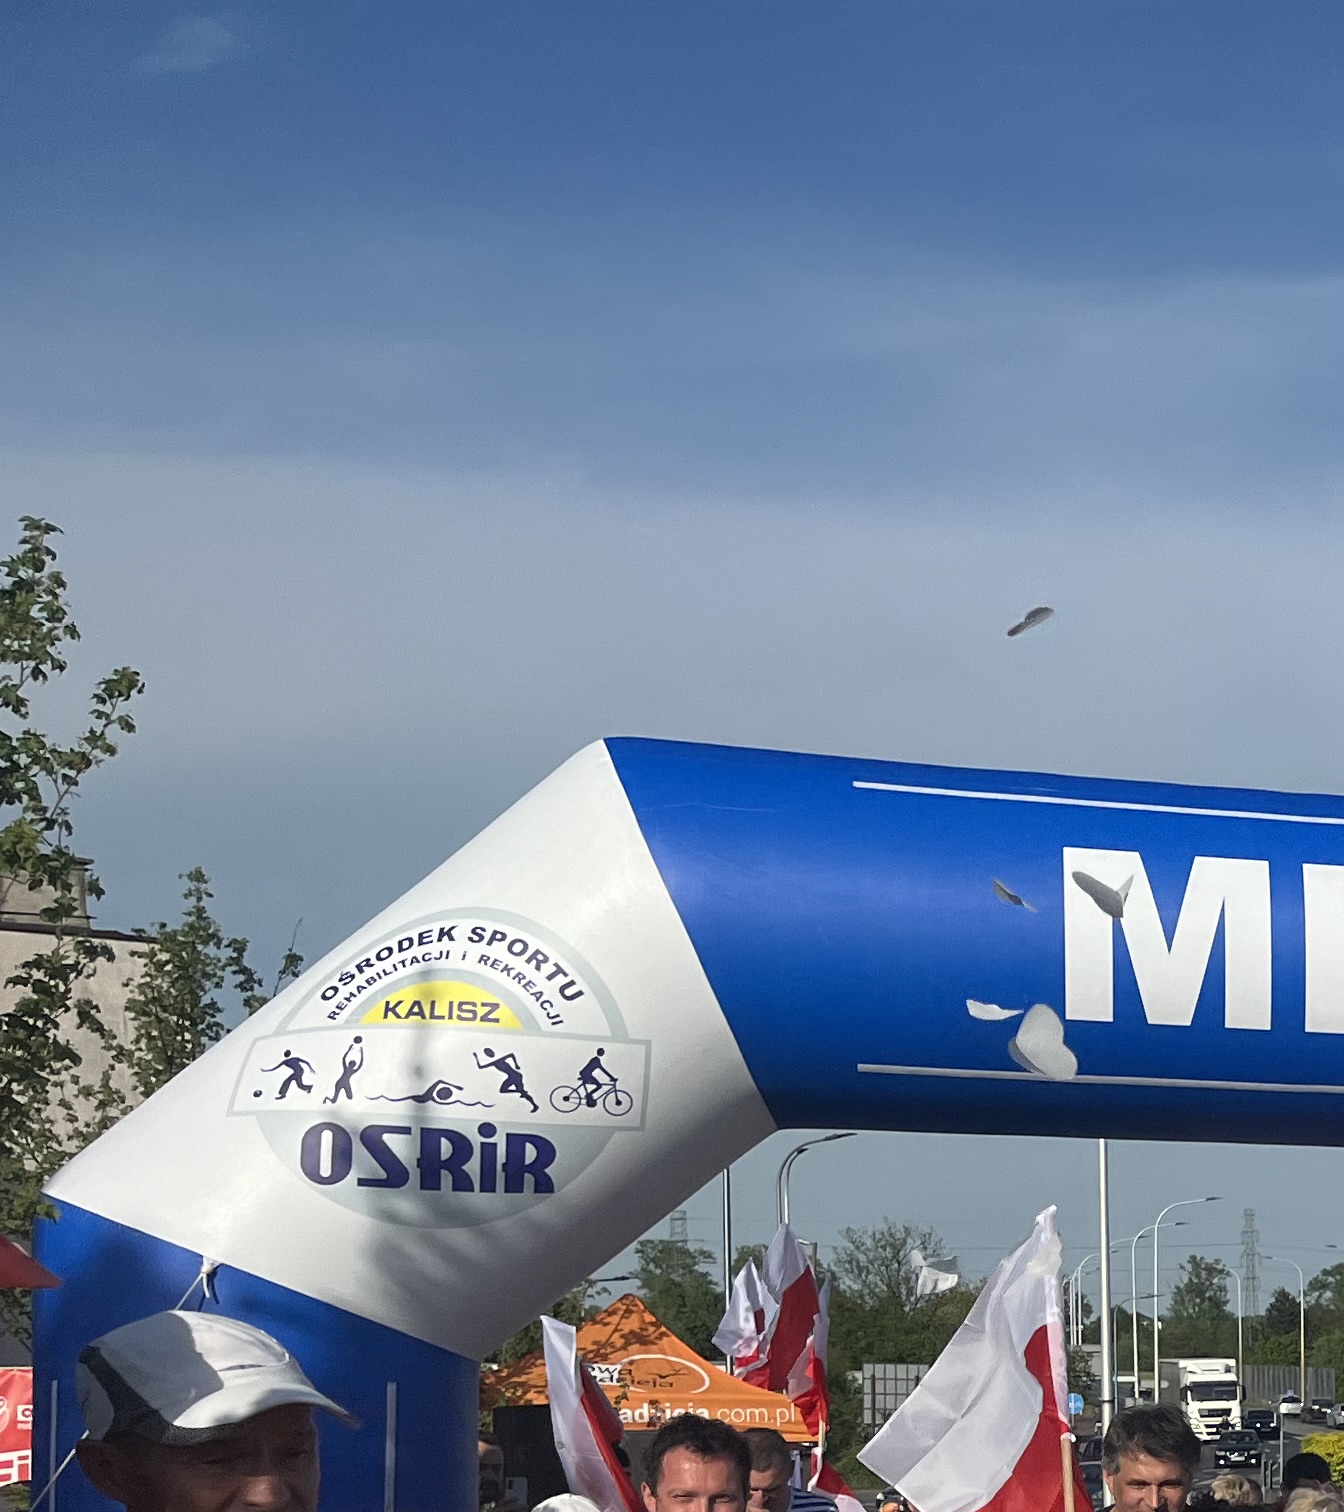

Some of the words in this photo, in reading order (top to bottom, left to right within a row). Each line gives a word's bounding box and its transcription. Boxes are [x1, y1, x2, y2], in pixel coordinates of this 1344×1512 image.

[320, 925, 459, 1002] OŚRODEK
[467, 926, 585, 1002] SPORTU
[478, 954, 564, 1027] REKREACJI
[383, 1000, 501, 1023] KALISZ
